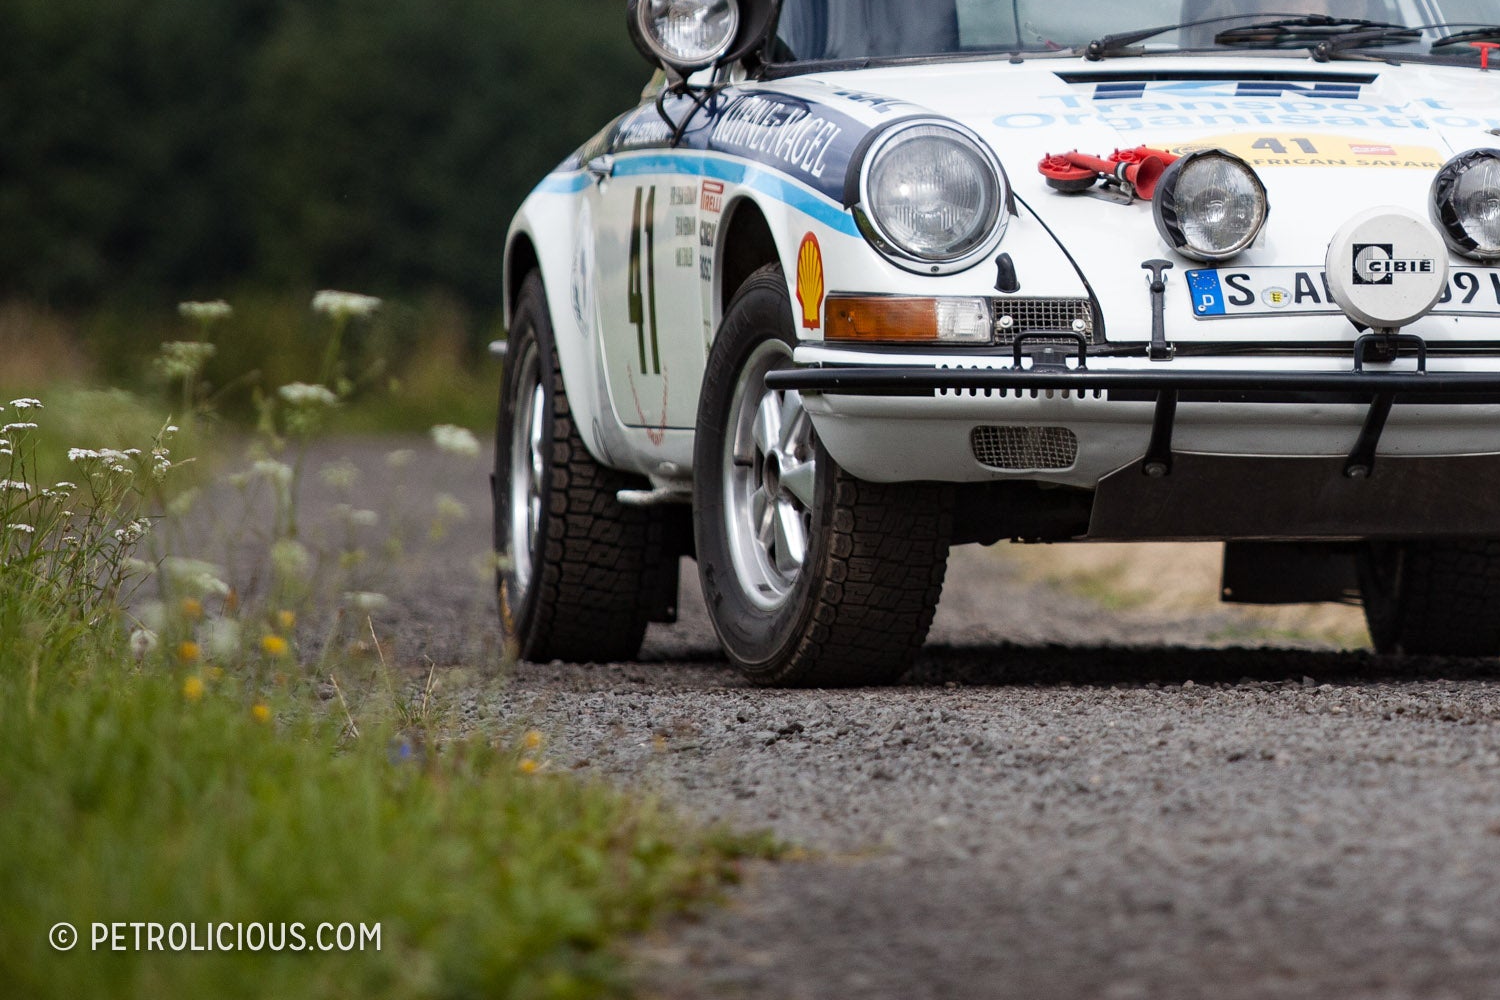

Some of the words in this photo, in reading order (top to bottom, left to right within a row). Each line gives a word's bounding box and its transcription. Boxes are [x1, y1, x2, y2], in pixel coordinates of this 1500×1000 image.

[1037, 94, 1454, 114] Transport
[767, 108, 842, 178] NAGEL
[1251, 137, 1319, 155] 41
[626, 184, 661, 375] 41
[1224, 273, 1256, 306] S
[1294, 271, 1336, 304] A
[1202, 294, 1215, 306] D
